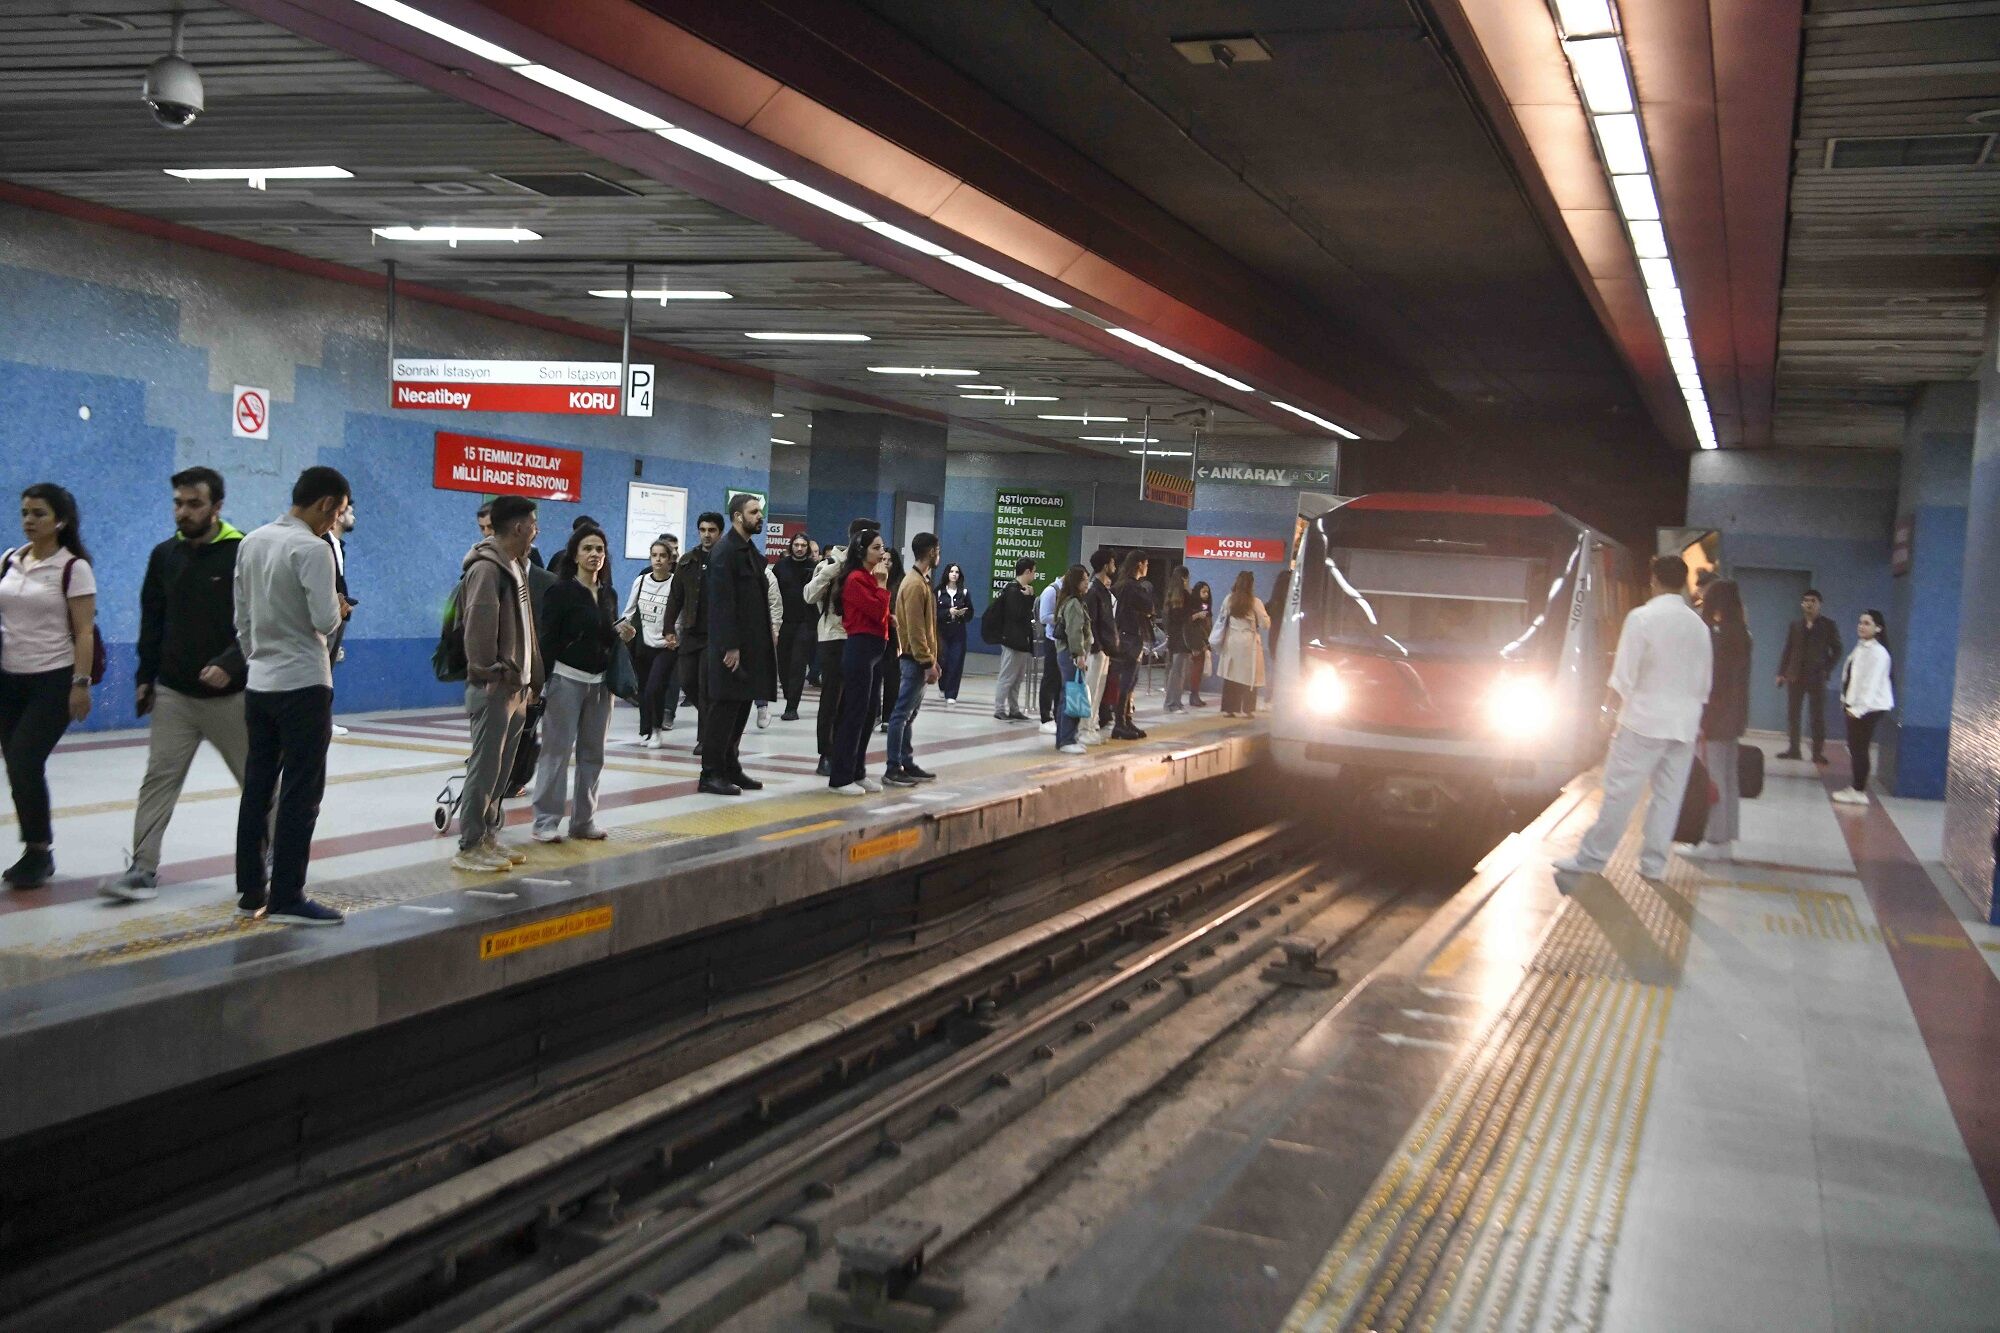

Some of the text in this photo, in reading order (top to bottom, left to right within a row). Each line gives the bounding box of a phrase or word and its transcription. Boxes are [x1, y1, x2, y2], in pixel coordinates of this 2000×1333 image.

[397, 362, 617, 381] Sonraki İstasyon Son İstasyon
[631, 370, 650, 398] P
[398, 387, 616, 409] Necatibey KORU
[640, 391, 650, 410] 4
[464, 446, 561, 471] 15 TEMMUZ KIZILAY
[452, 463, 569, 491] MİLLİ İRADE İSTASYONU
[1210, 467, 1286, 481] ANKARAY
[999, 495, 1064, 507] AŞTİ(OTOGAR)
[998, 506, 1024, 515] EMEK
[997, 516, 1066, 528] BAHÇELİEVLER
[996, 527, 1044, 537] BEŞEVLER
[996, 538, 1042, 548] ANADOLU/
[1218, 539, 1252, 549] KORU
[995, 548, 1045, 559] ANITKABİR
[1203, 549, 1266, 560] PLATFORMU
